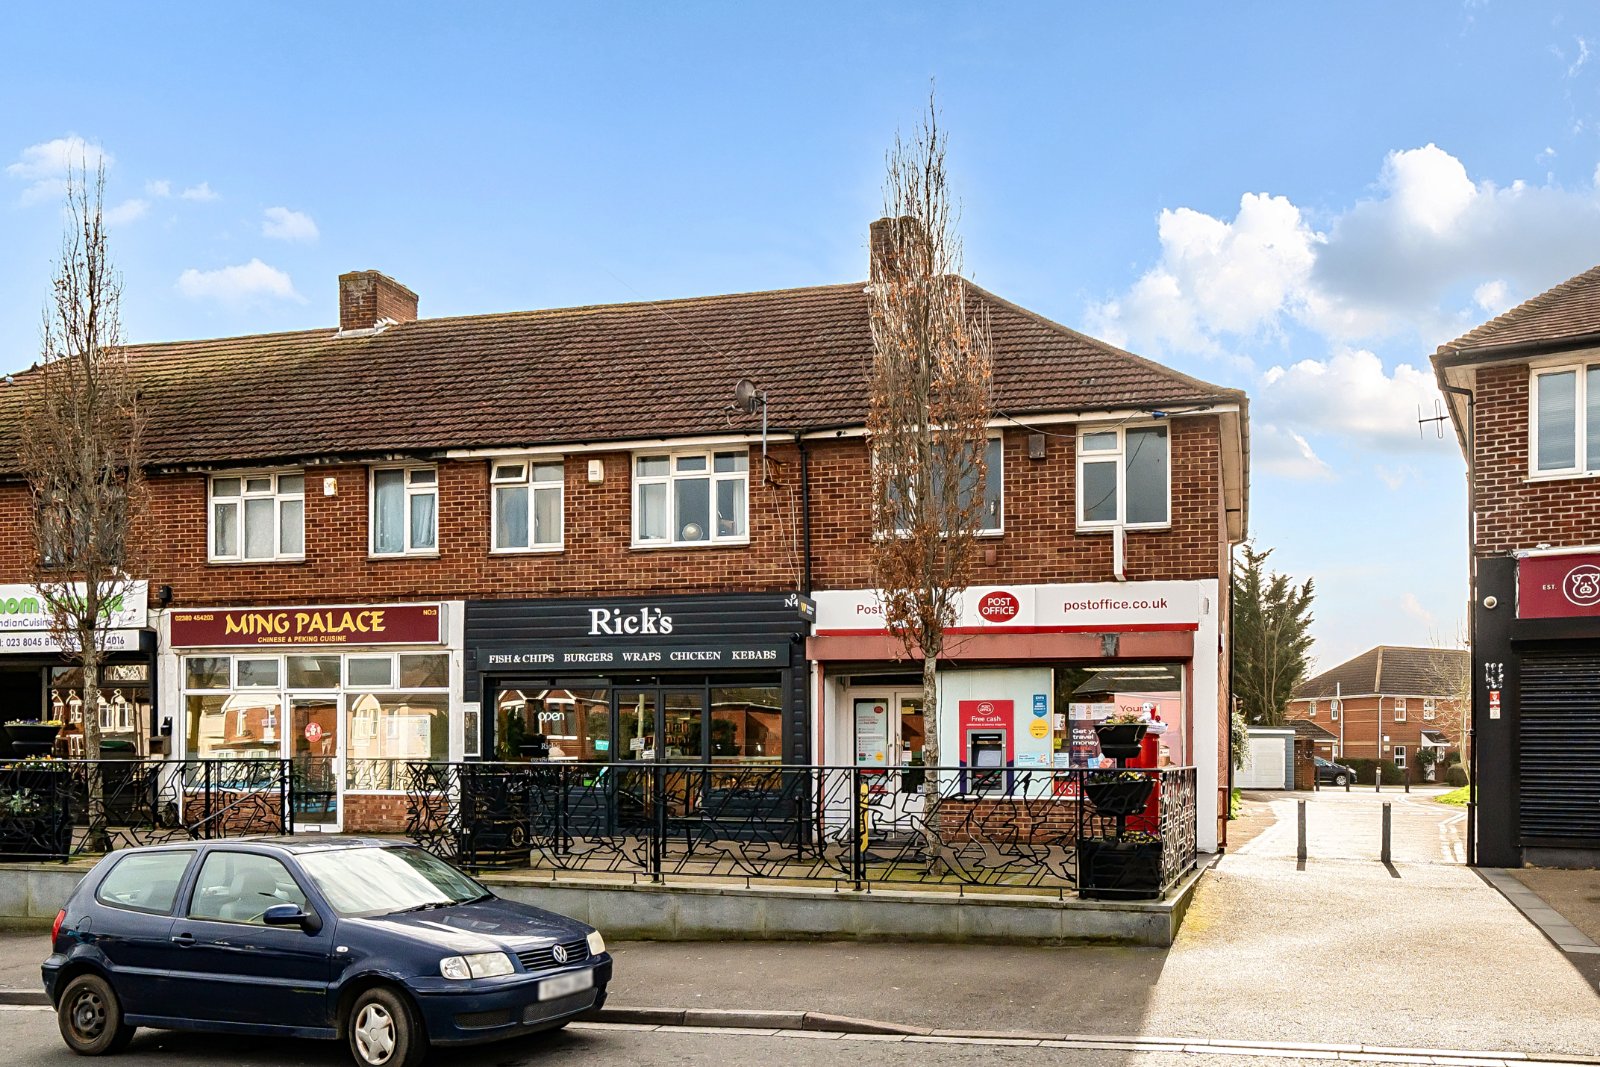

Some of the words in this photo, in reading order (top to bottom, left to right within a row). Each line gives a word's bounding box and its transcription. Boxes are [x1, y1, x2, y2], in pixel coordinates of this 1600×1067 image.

[987, 597, 1011, 606] POST
[1064, 598, 1168, 613] postoffice.co.uk
[857, 604, 882, 615] Post
[981, 606, 1015, 615] OFFICE
[225, 613, 290, 635] MING
[295, 611, 386, 633] PALACE
[588, 607, 673, 635] Rick's
[6, 638, 20, 647] 023
[23, 637, 42, 646] 8045
[489, 654, 513, 664] FISH
[513, 654, 522, 663] &
[522, 653, 555, 663] CHIPS
[564, 652, 613, 662] BURGERS
[622, 652, 661, 661] WRAPS
[670, 651, 721, 661] CHICKEN
[732, 650, 777, 660] KEBABS
[538, 712, 565, 722] open
